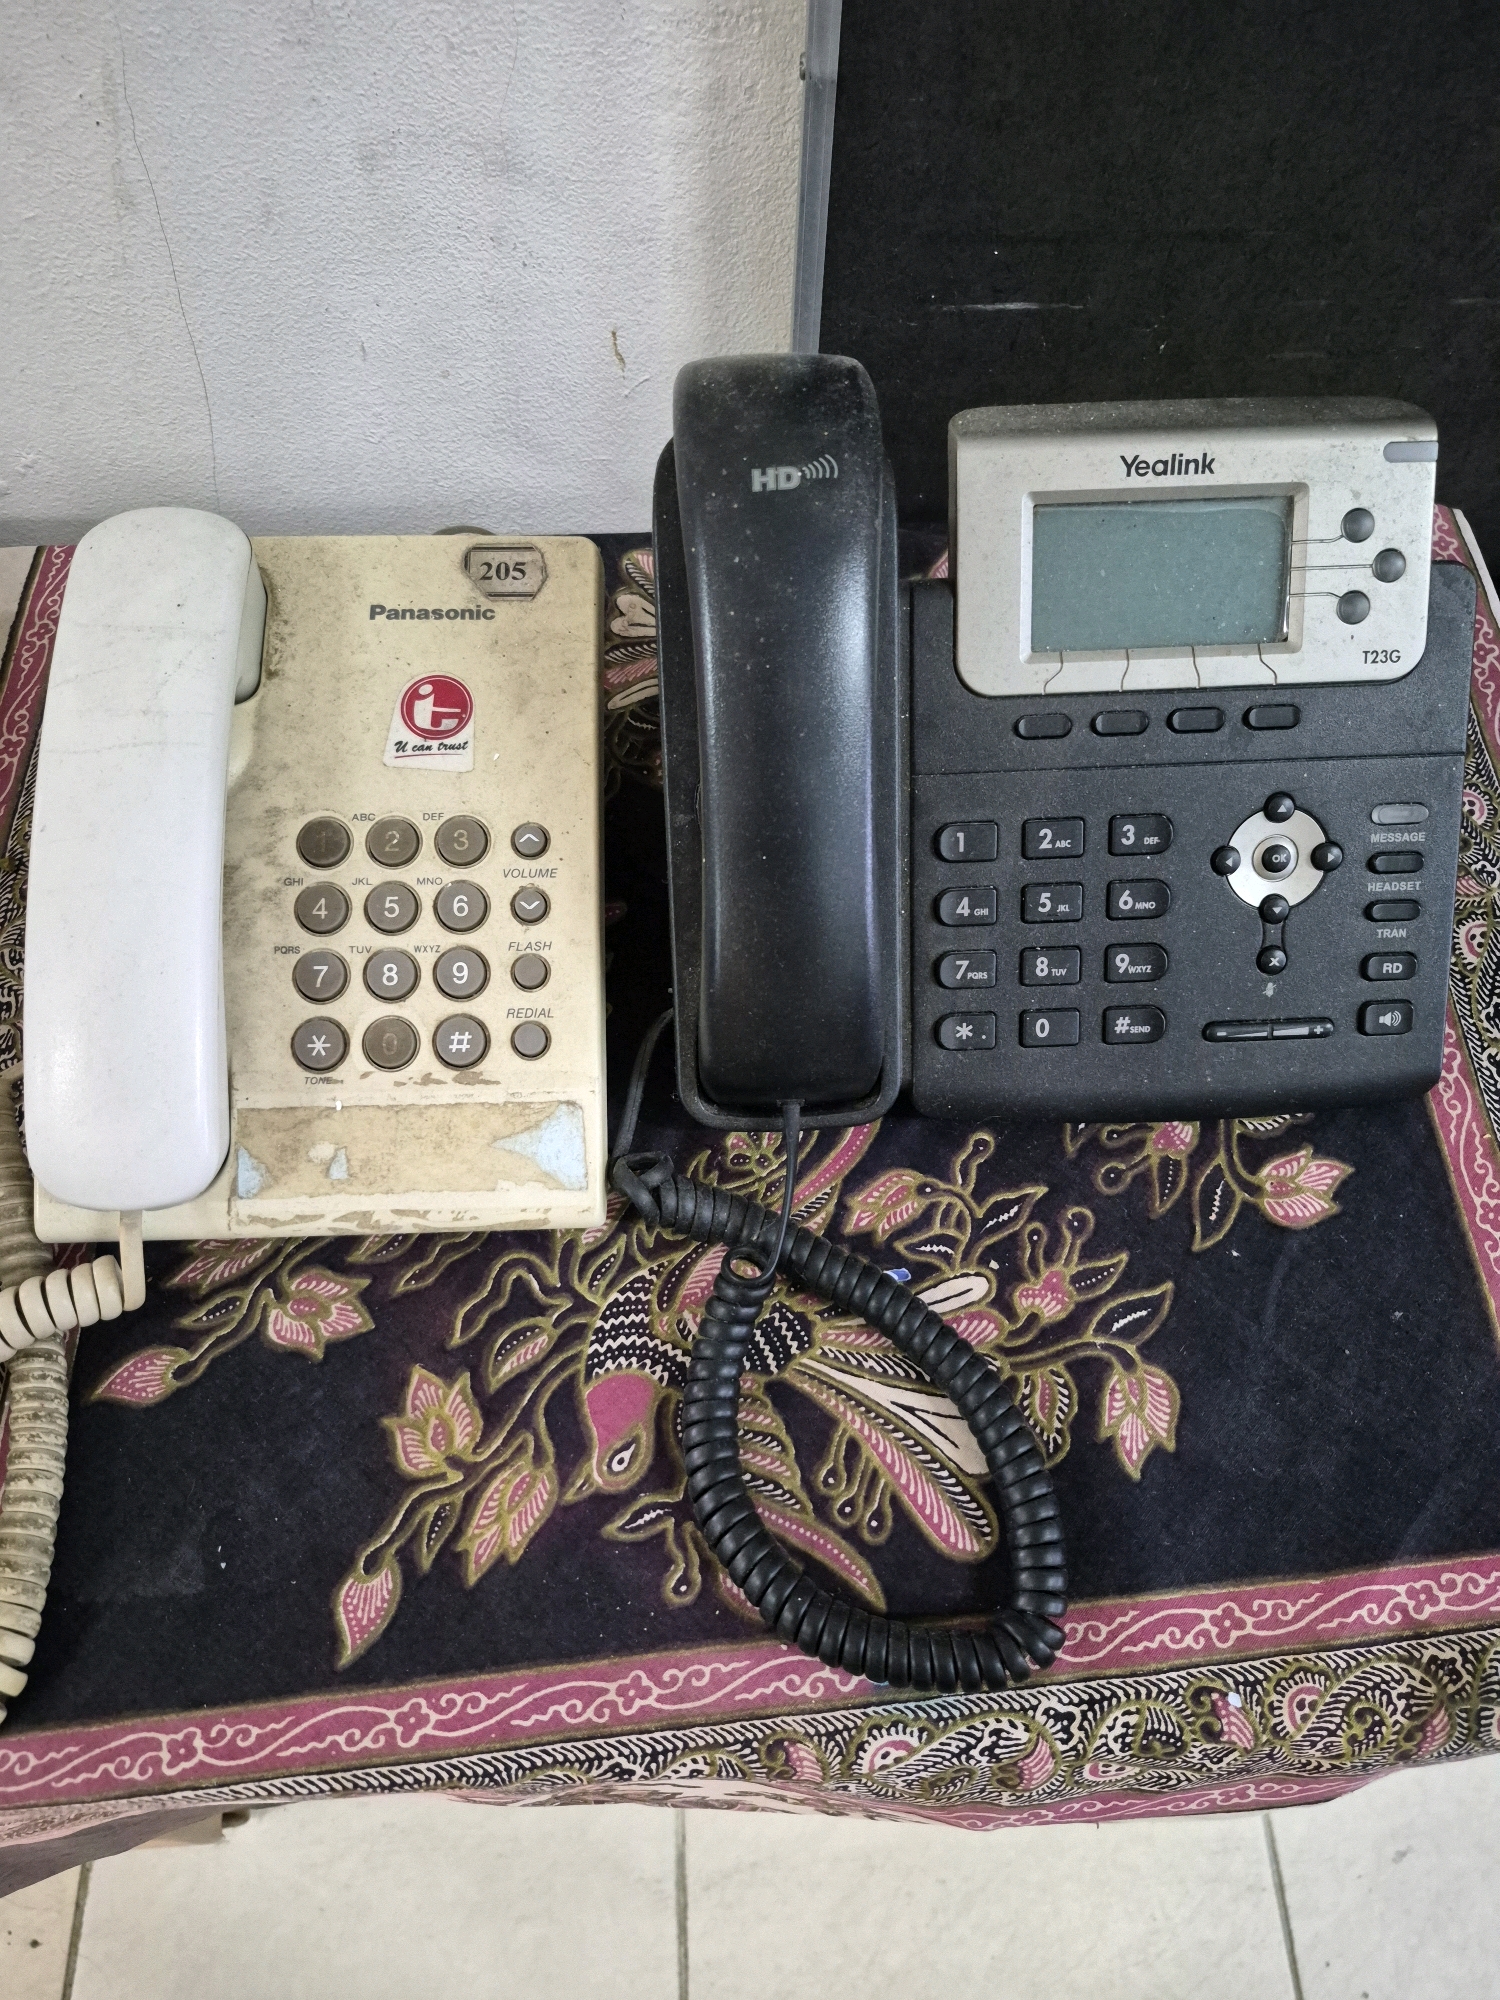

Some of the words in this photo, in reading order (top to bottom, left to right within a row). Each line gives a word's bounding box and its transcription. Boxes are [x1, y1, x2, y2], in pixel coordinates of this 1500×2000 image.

[1120, 453, 1216, 477] Yealink
[751, 466, 801, 492] HD
[479, 561, 527, 581] 205
[369, 605, 496, 620] Panasonic
[1362, 650, 1401, 664] T23G
[438, 741, 468, 751] trust
[352, 813, 375, 821] ABC
[423, 812, 444, 821] DEF
[384, 831, 400, 852] 2
[454, 829, 469, 850] 3
[956, 833, 964, 852] 1
[1039, 829, 1052, 849] 2
[1121, 825, 1135, 845] 3
[1371, 832, 1426, 843] MESSAGE
[1272, 854, 1287, 863] OK
[352, 877, 372, 886] JKL
[417, 877, 443, 886] MNO
[503, 868, 557, 879] VOLUME
[284, 878, 303, 886] GHI
[1368, 881, 1420, 892] HEADSET
[384, 896, 400, 917] 5
[452, 895, 468, 916] 6
[956, 897, 970, 916] 4
[974, 908, 988, 916] GHI
[1038, 893, 1051, 912] 5
[1118, 890, 1133, 910] 6
[1135, 901, 1155, 909] MNO
[312, 898, 328, 919] 4
[1377, 929, 1406, 938] TRAN
[274, 946, 300, 954] PQRS
[350, 946, 372, 954] TUV
[414, 945, 441, 953] WXYZ
[508, 941, 552, 951] FLASH
[956, 960, 969, 979] 7
[967, 972, 987, 980] PQRS
[1036, 957, 1048, 976] 8
[1052, 968, 1067, 976] TUV
[1116, 954, 1129, 973] 9
[1128, 965, 1151, 973] WXYZ
[1382, 963, 1402, 973] RD
[313, 966, 328, 987] 7
[382, 964, 398, 985] 8
[452, 962, 468, 983] 9
[506, 1008, 554, 1018] REDIAL
[1035, 1019, 1049, 1037] 0
[1130, 1025, 1150, 1033] SEND
[304, 1076, 333, 1084] TONE
